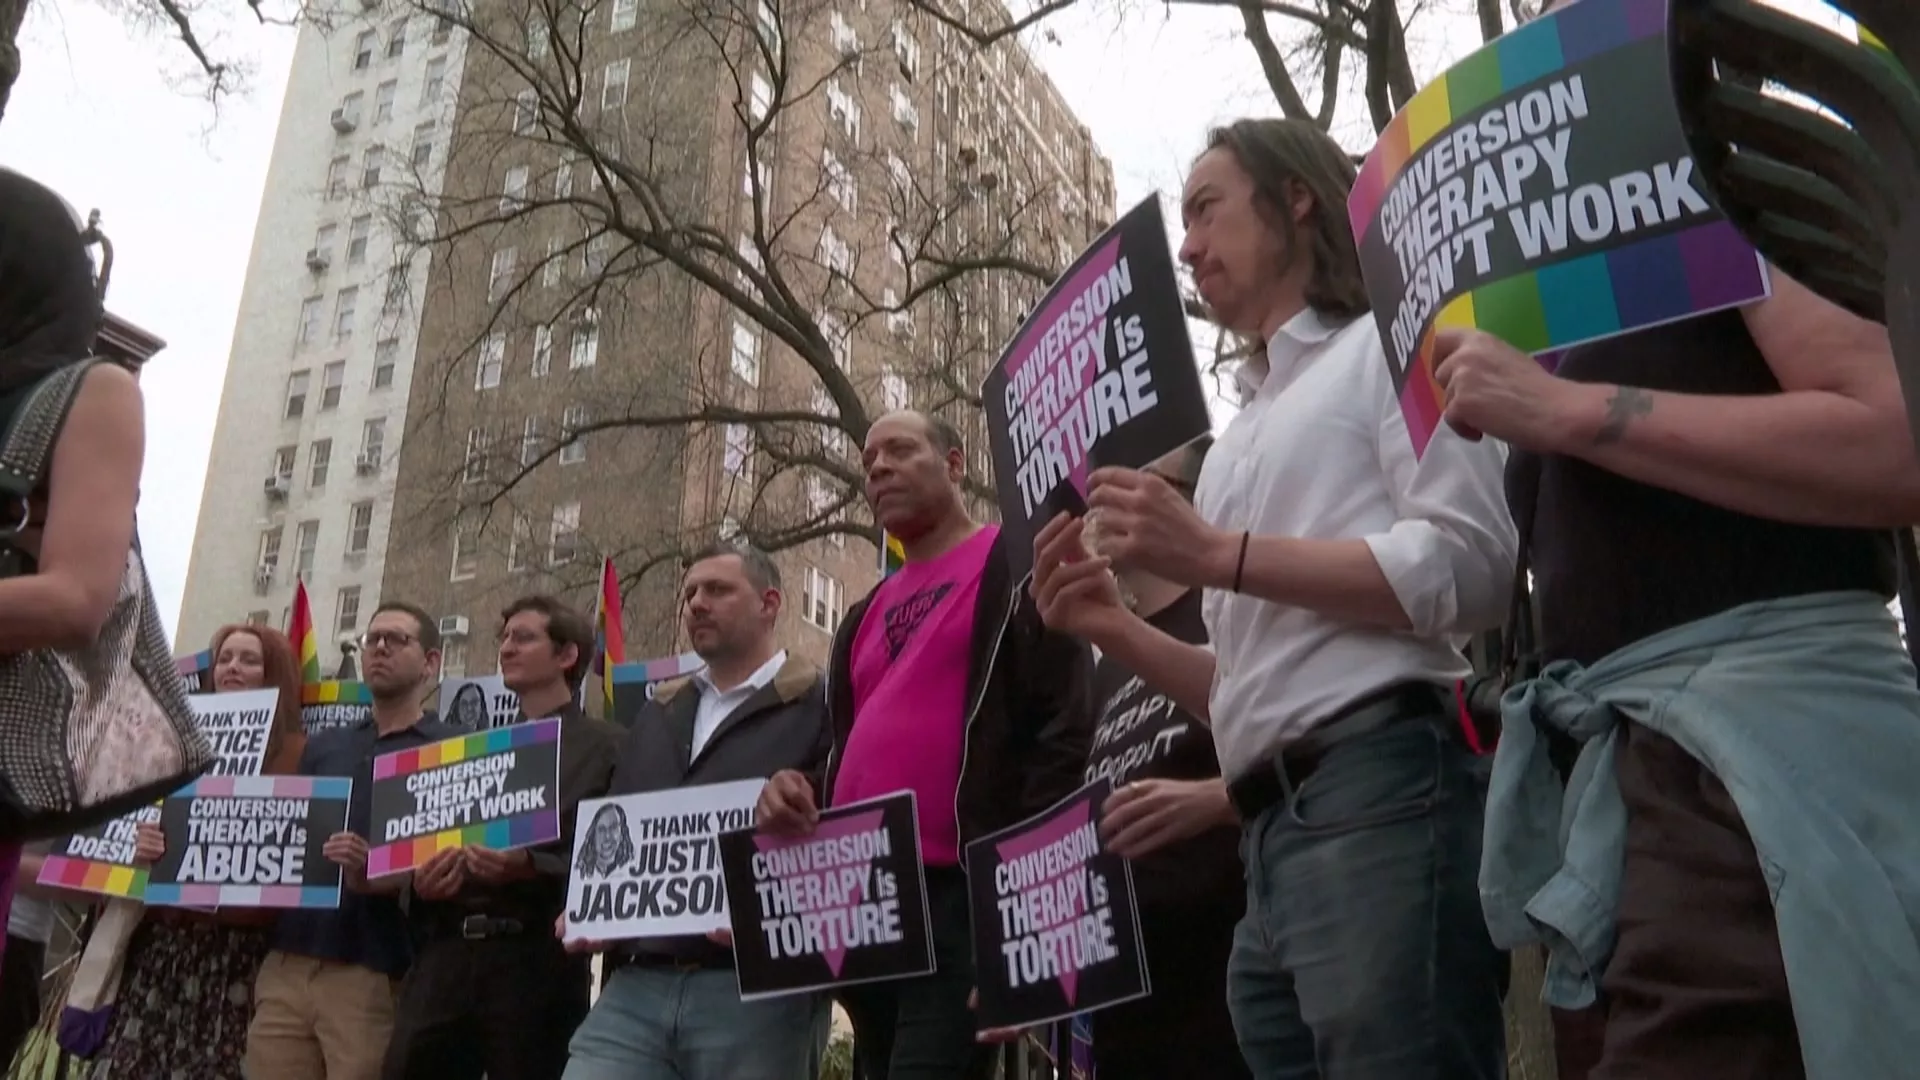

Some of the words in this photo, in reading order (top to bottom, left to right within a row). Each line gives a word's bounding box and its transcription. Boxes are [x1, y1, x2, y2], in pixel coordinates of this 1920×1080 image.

[1380, 74, 1588, 246] CONVERSION
[1394, 127, 1571, 285] THERAPY
[1390, 217, 1494, 374] DOESN'T
[1508, 156, 1710, 261] WORK
[1004, 256, 1133, 416] CONVERSION
[1009, 317, 1109, 466] THERAPY
[1113, 314, 1145, 357] is
[1016, 349, 1159, 520] TORTURE
[239, 708, 270, 726] YOU
[406, 752, 516, 793] CONVERSION
[415, 772, 507, 813] THERAPY
[188, 818, 289, 844] THERAPY
[290, 823, 307, 844] is
[190, 798, 310, 819] CONVERSION
[385, 802, 474, 842] DOESN'T
[480, 786, 546, 820] WORK
[640, 812, 711, 840] THANK
[176, 845, 306, 884] ABUSE
[629, 837, 720, 877] JUSTI
[752, 826, 891, 880] CONVERSION
[995, 819, 1100, 896] CONVERSION
[755, 863, 873, 917] THERAPY
[876, 868, 897, 899] is
[997, 864, 1088, 939] THERAPY
[1090, 873, 1109, 907] is
[761, 900, 904, 960] TORTURE
[1001, 908, 1119, 988] TORTURE
